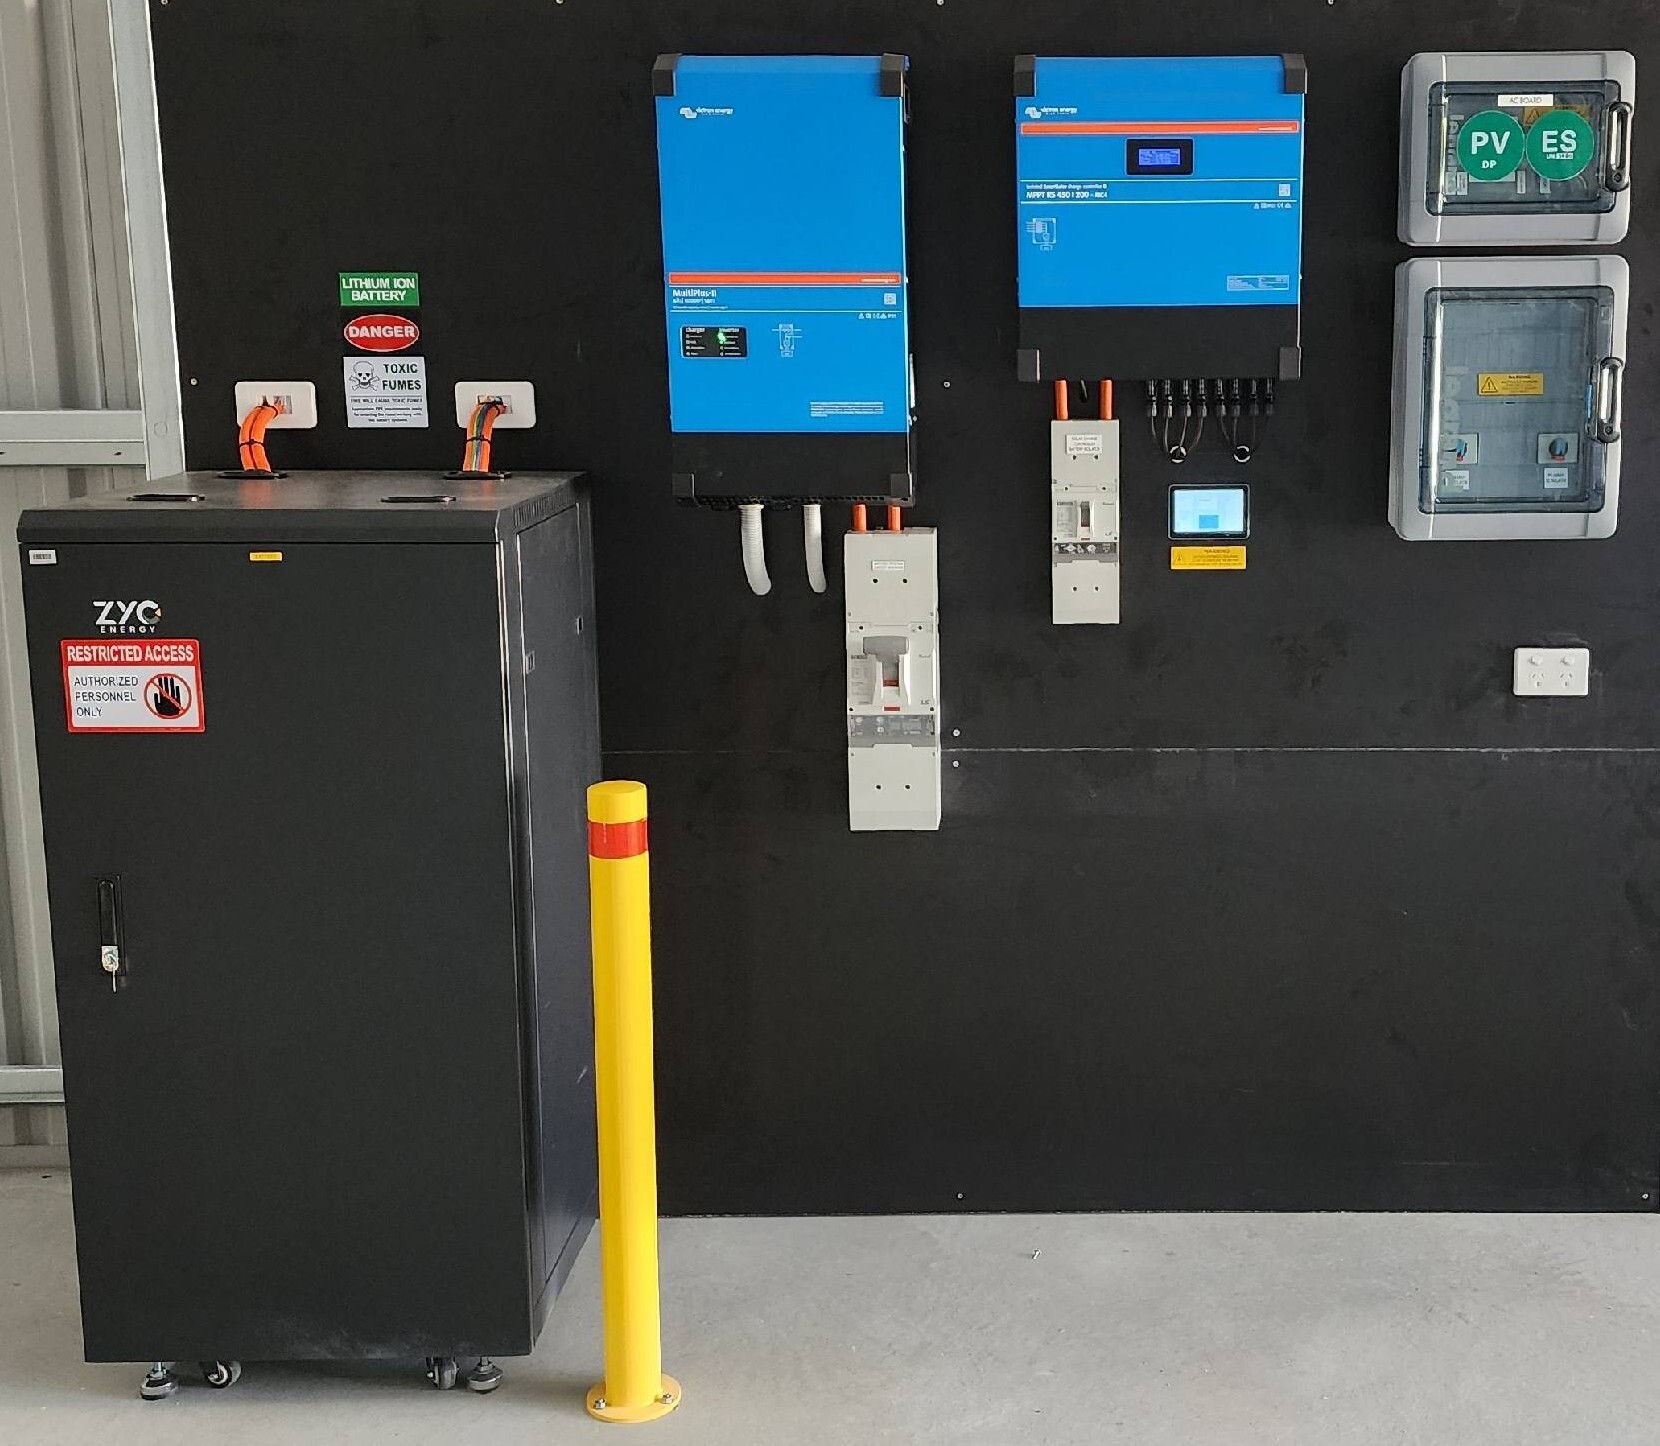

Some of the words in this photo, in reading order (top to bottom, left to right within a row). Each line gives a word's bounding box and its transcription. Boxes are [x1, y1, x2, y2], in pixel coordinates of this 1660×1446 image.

[1510, 96, 1519, 104] AC
[1471, 131, 1511, 155] PV
[1542, 129, 1577, 153] ES
[1481, 160, 1497, 169] DP
[1026, 191, 1045, 199] MPPT
[342, 277, 390, 289] LITHIUM
[393, 277, 415, 289] ION
[351, 290, 407, 301] BATTERY
[348, 325, 416, 338] DANGER
[383, 363, 418, 374] TOXIC
[382, 380, 422, 391] FUMES
[93, 600, 162, 625] ZYC
[100, 625, 156, 634] ENERGY
[66, 645, 143, 662] RESTRICTED
[144, 644, 194, 662] ACCESS
[75, 691, 137, 702] PERSONNEL
[76, 706, 103, 717] ONLY
